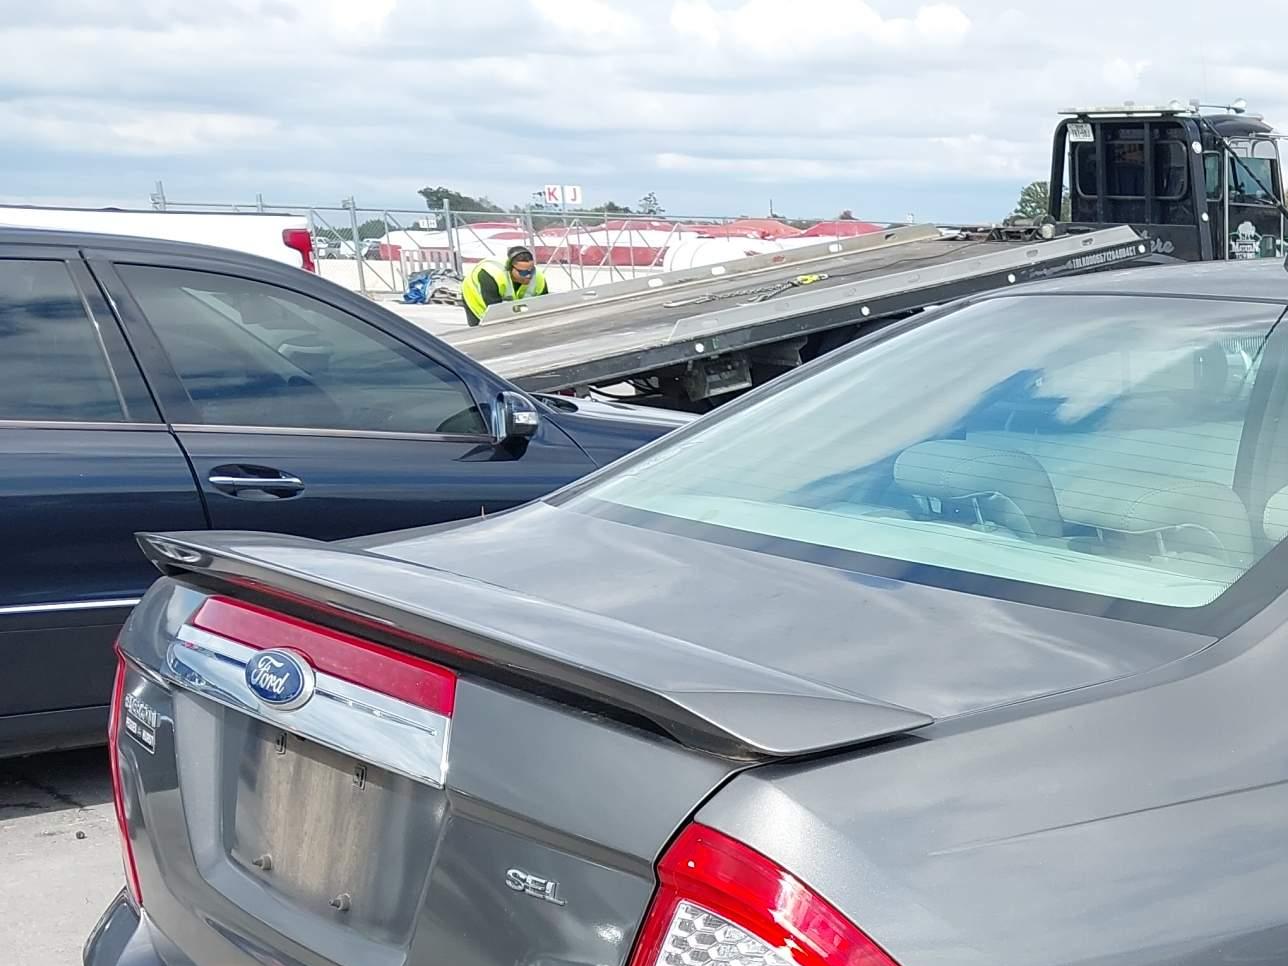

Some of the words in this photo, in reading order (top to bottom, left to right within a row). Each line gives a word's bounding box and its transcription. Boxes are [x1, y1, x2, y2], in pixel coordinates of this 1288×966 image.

[547, 187, 559, 201] K
[570, 187, 577, 202] J
[250, 655, 290, 695] Ford
[505, 869, 567, 905] SEL
